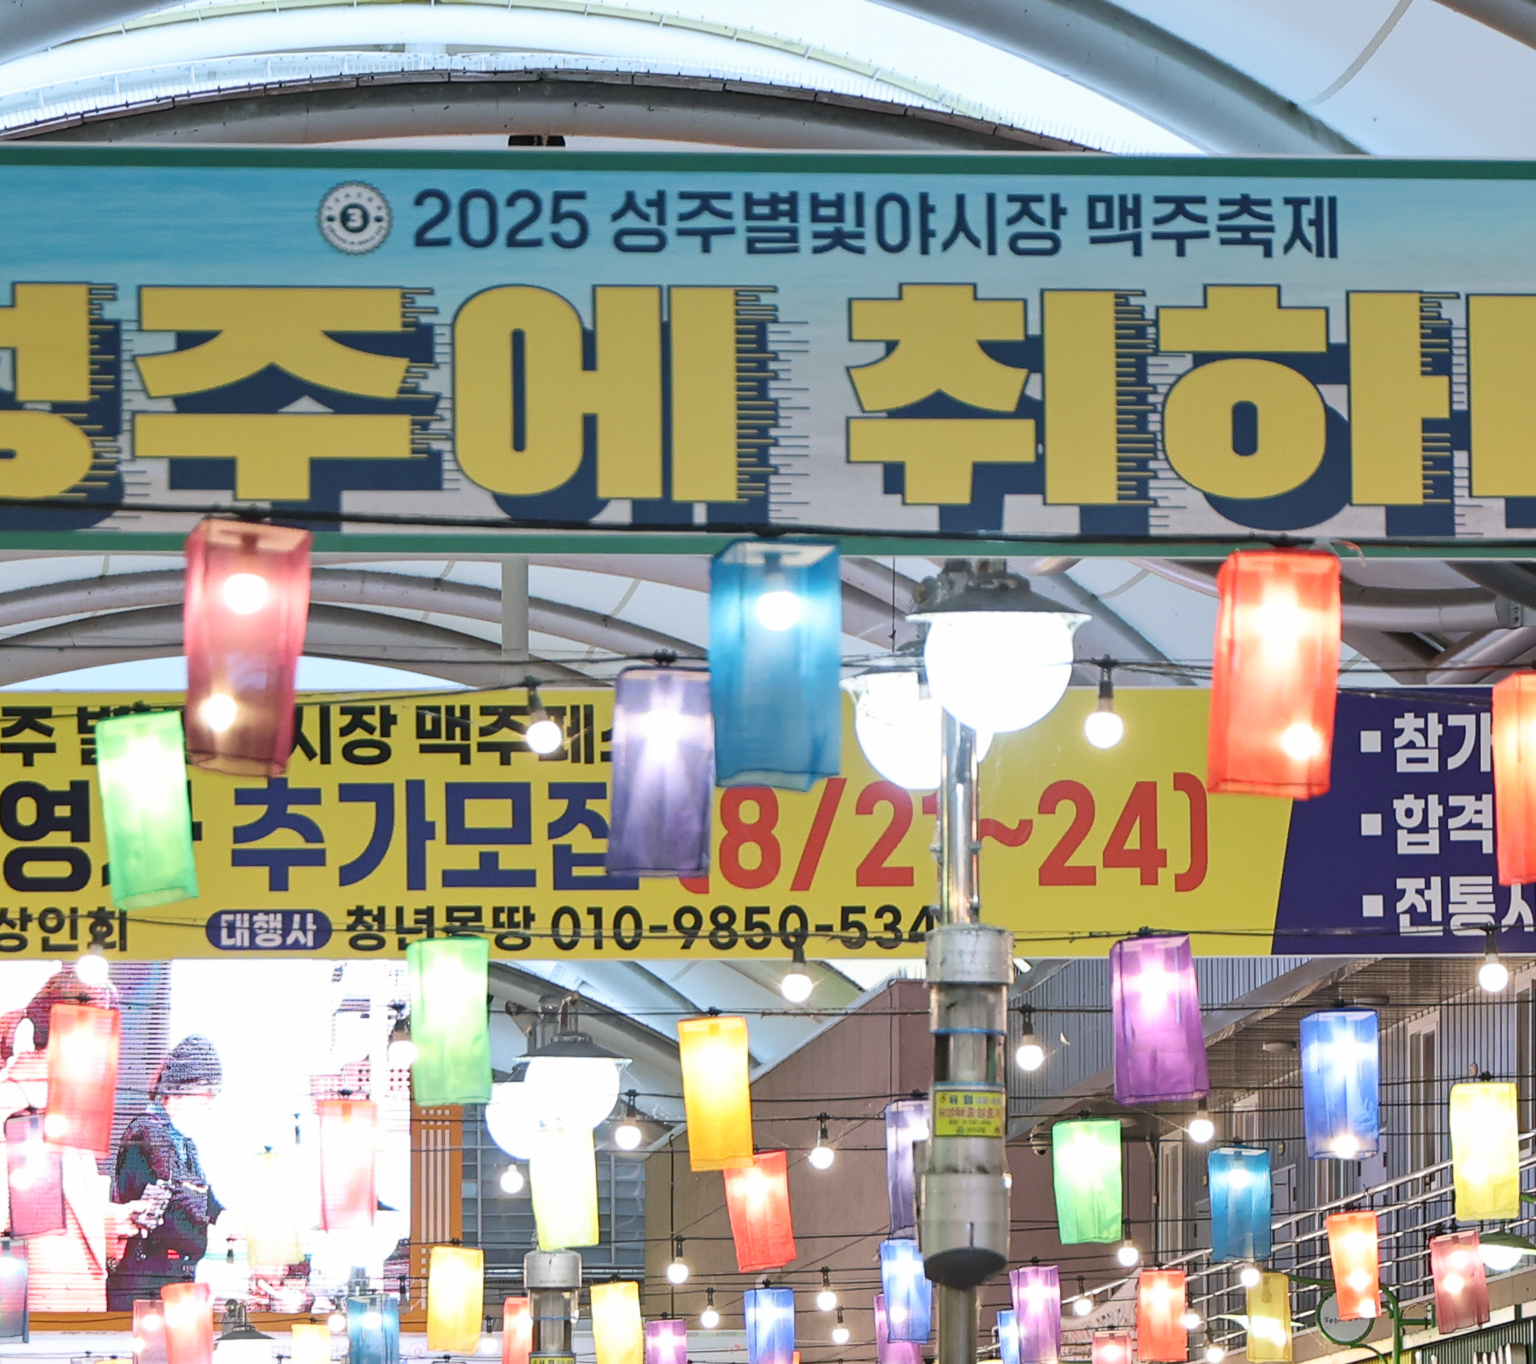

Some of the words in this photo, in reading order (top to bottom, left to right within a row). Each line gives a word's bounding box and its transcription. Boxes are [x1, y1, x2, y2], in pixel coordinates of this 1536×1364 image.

[413, 187, 591, 250] 2025
[611, 189, 1067, 257] 성주별빛야시장
[1087, 193, 1339, 259] 맥주축제
[220, 913, 317, 948] 대행사
